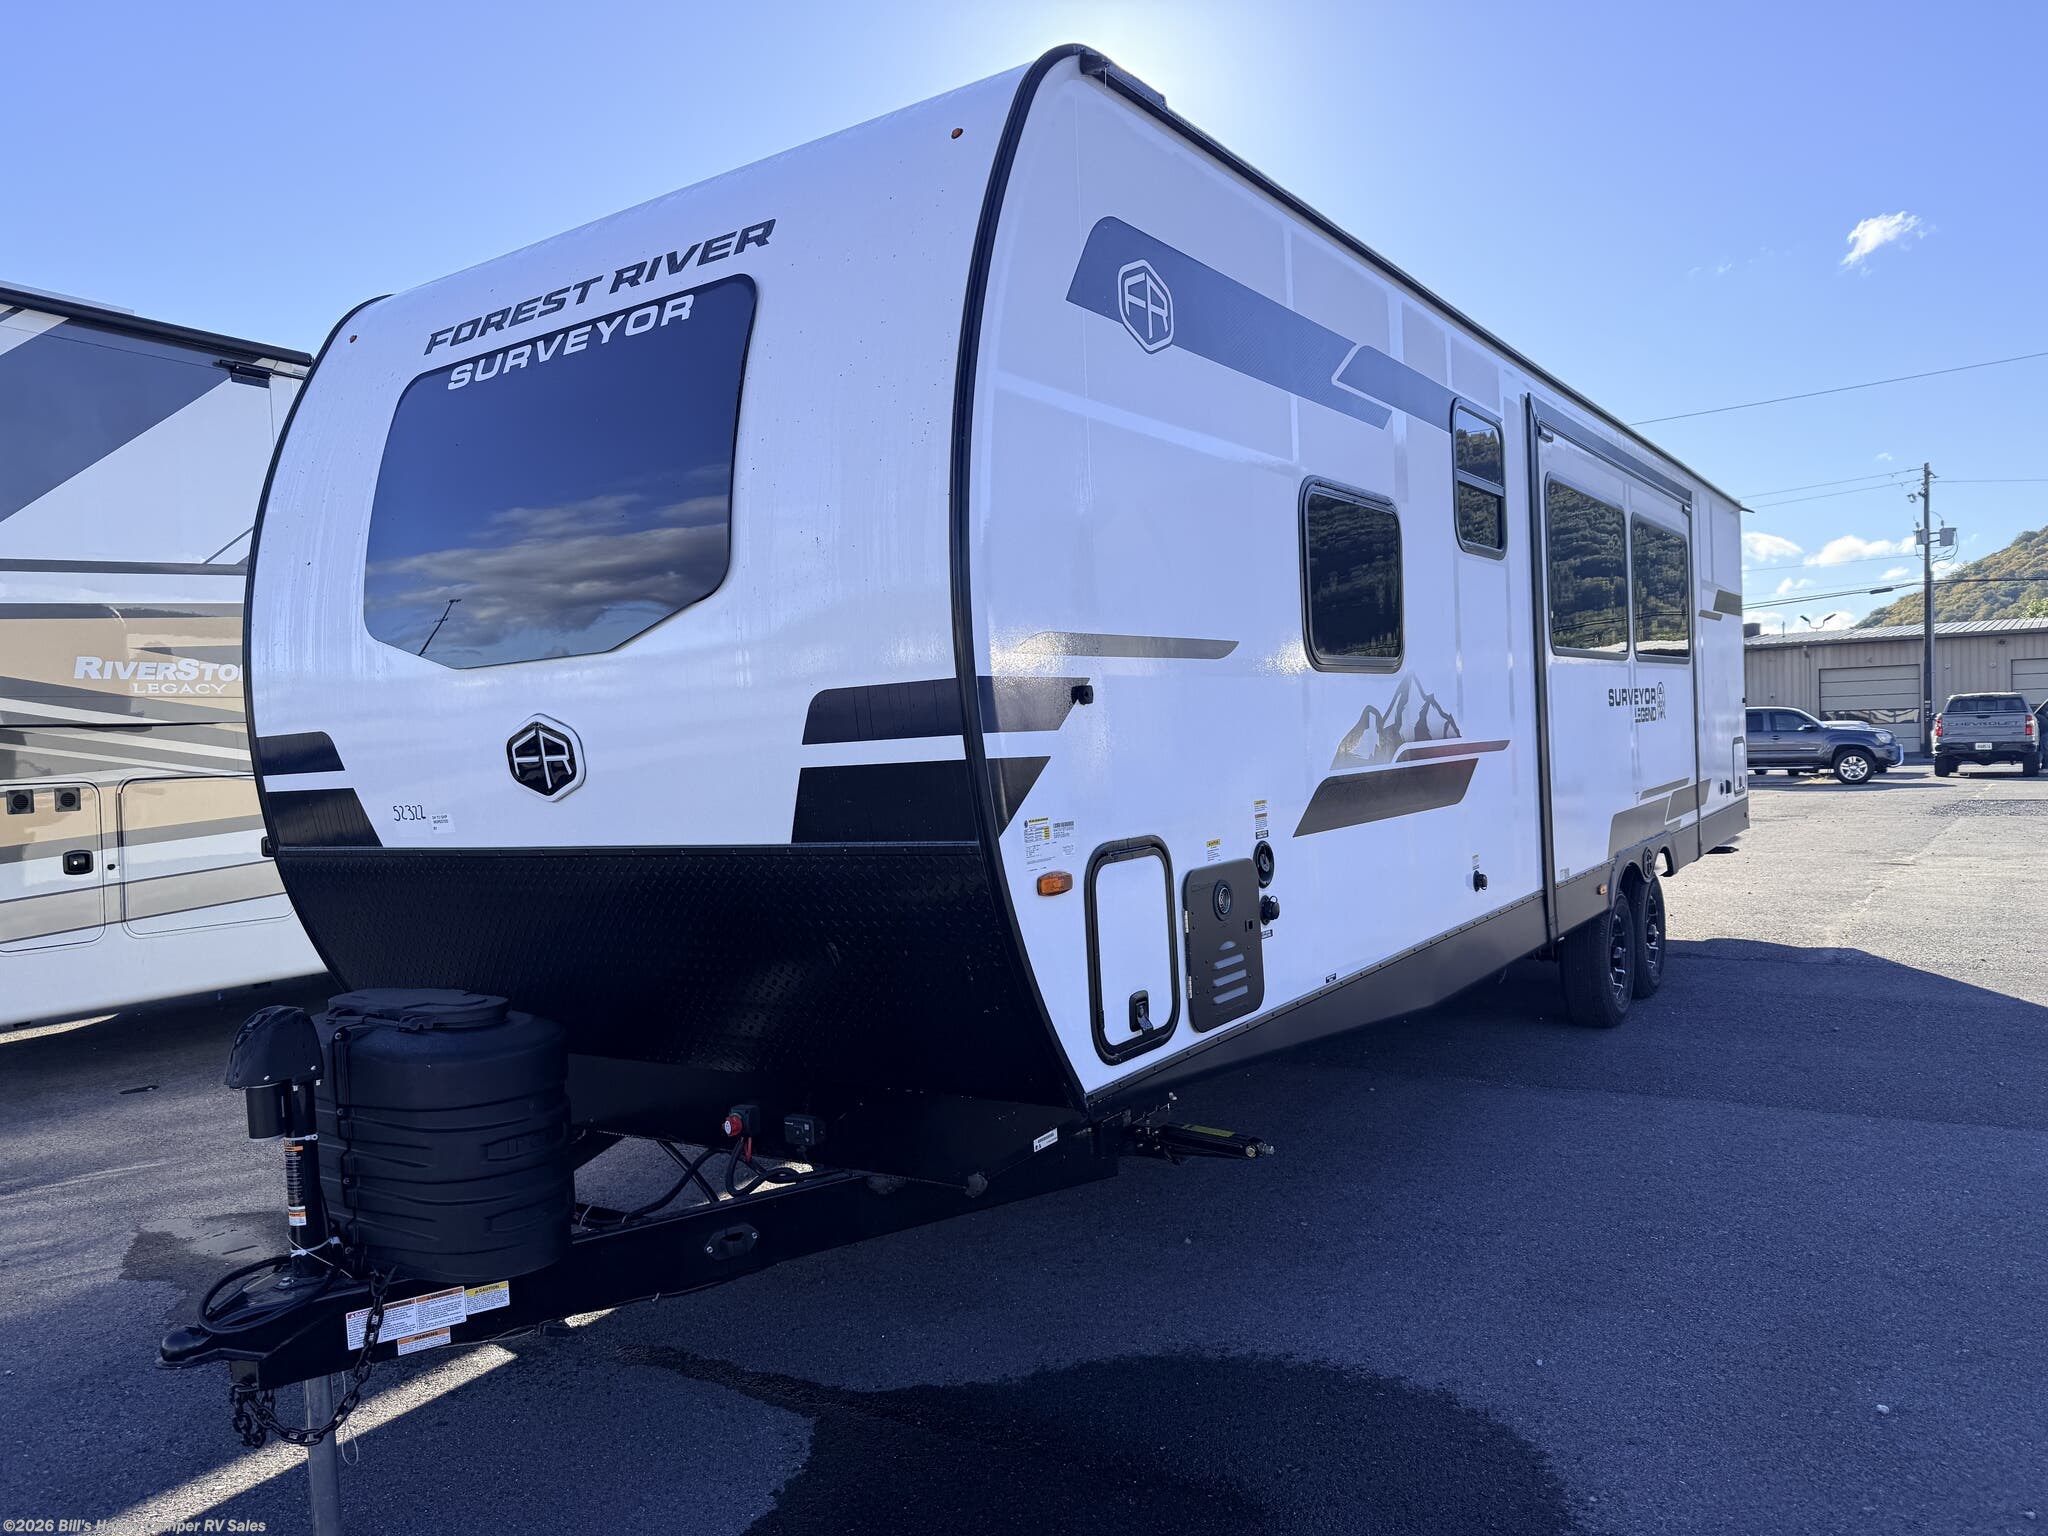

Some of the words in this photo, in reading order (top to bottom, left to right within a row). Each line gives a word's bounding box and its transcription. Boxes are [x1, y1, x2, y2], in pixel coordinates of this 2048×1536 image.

[424, 275, 604, 356] FOREST
[609, 218, 776, 295] RIVER
[447, 294, 695, 390] SURVEYOR
[74, 655, 243, 682] RIVERSTO
[132, 683, 227, 694] LEGACY
[1608, 688, 1657, 707] SURVEYOR
[1634, 706, 1657, 723] LEGEND
[392, 804, 427, 822] 52322
